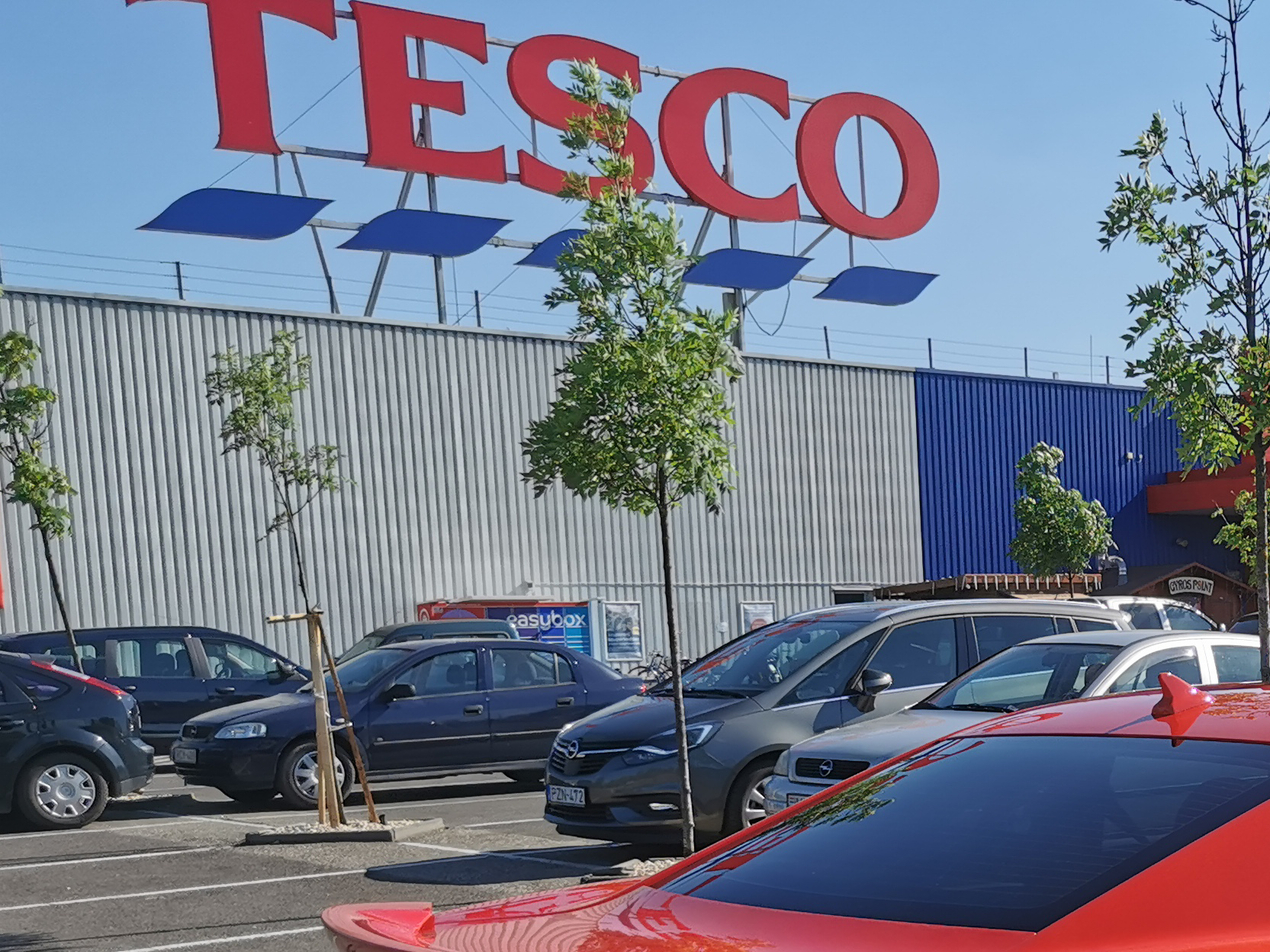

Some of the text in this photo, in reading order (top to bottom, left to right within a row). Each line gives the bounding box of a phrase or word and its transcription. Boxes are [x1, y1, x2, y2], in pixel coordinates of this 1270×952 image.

[125, 0, 940, 241] TESCO
[1170, 580, 1191, 591] GYROS
[507, 610, 587, 630] easybox
[551, 787, 584, 803] PZN-472
